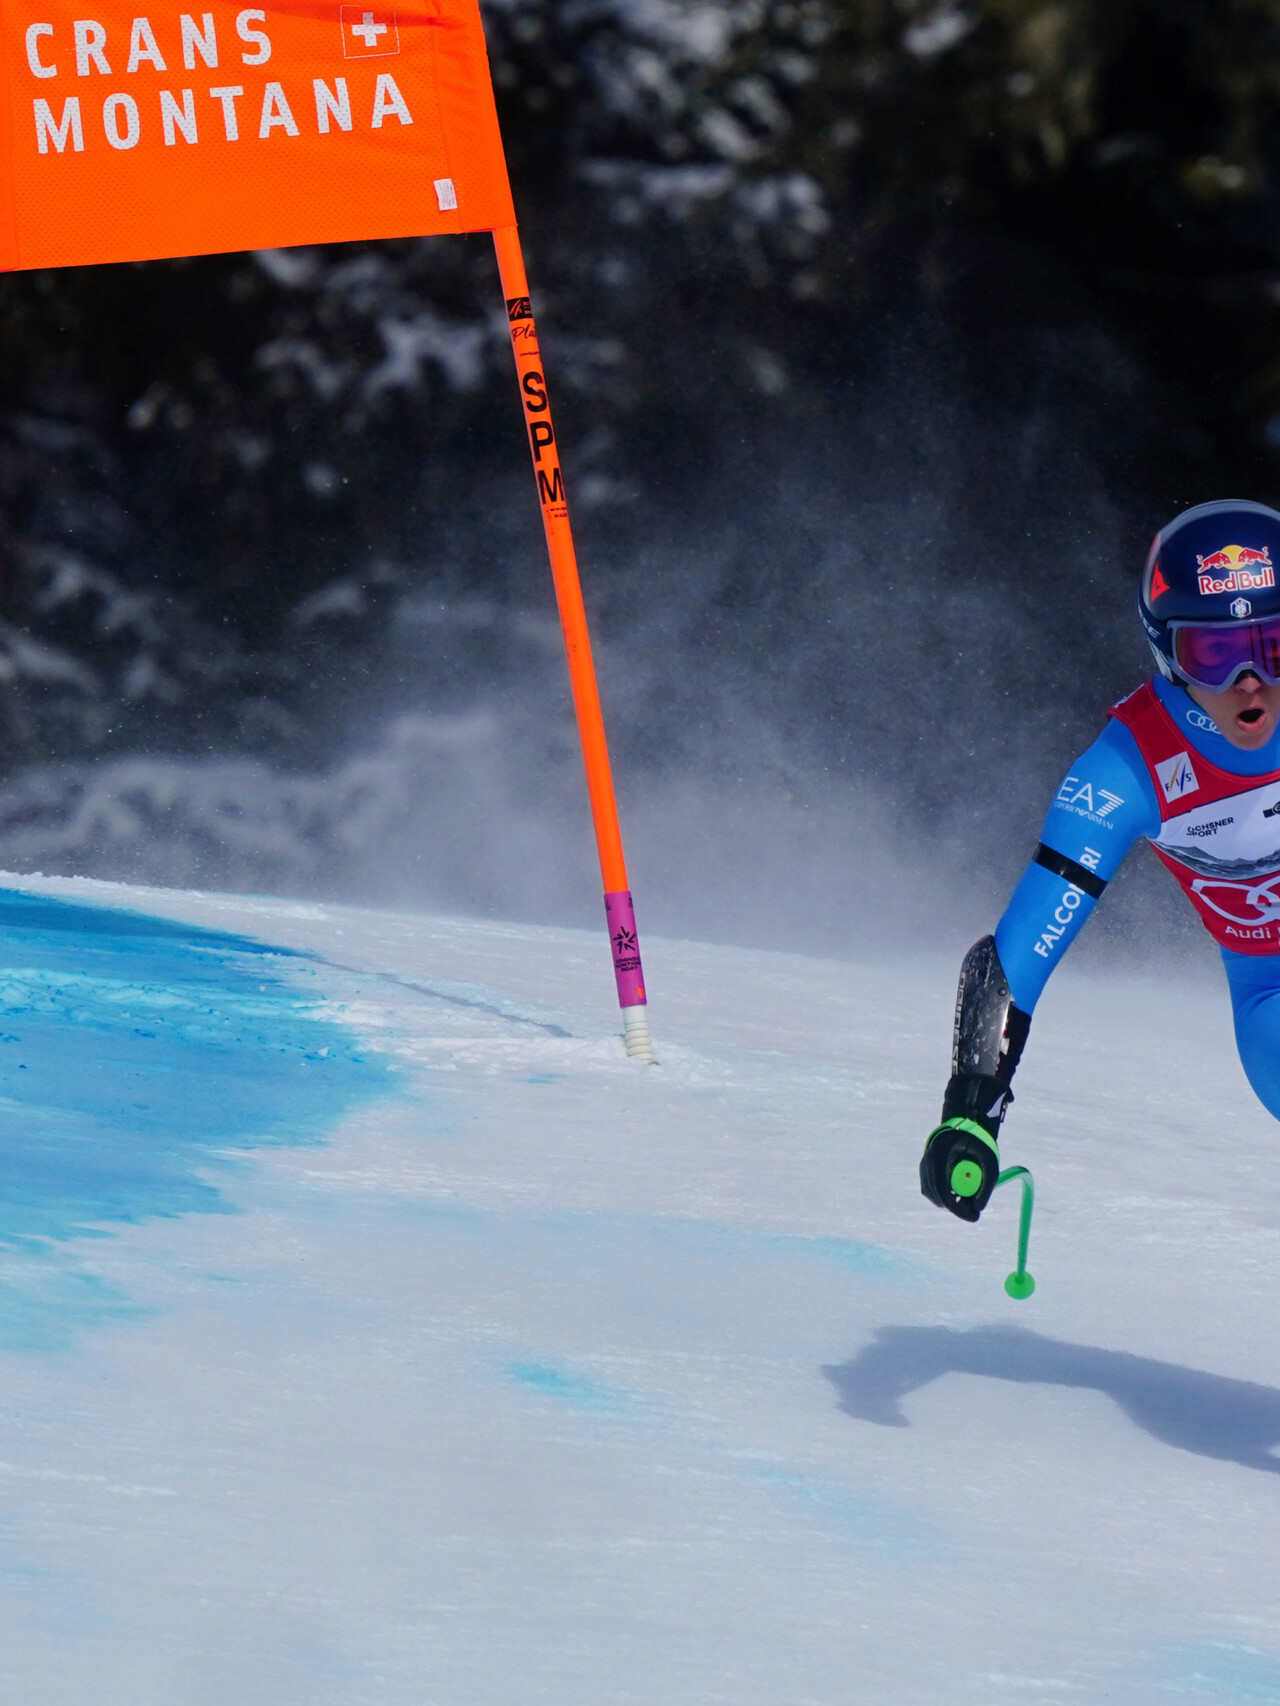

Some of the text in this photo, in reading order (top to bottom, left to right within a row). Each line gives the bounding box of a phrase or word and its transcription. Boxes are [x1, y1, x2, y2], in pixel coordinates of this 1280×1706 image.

[25, 9, 273, 79] CRANS
[33, 73, 413, 154] MONTANA
[1199, 567, 1275, 595] Red Bull
[1056, 777, 1125, 817] EA7
[1165, 771, 1192, 792] FIS
[1187, 817, 1234, 833] OCHSNER
[1033, 846, 1102, 958] FALCORI
[1225, 925, 1271, 939] Audi
